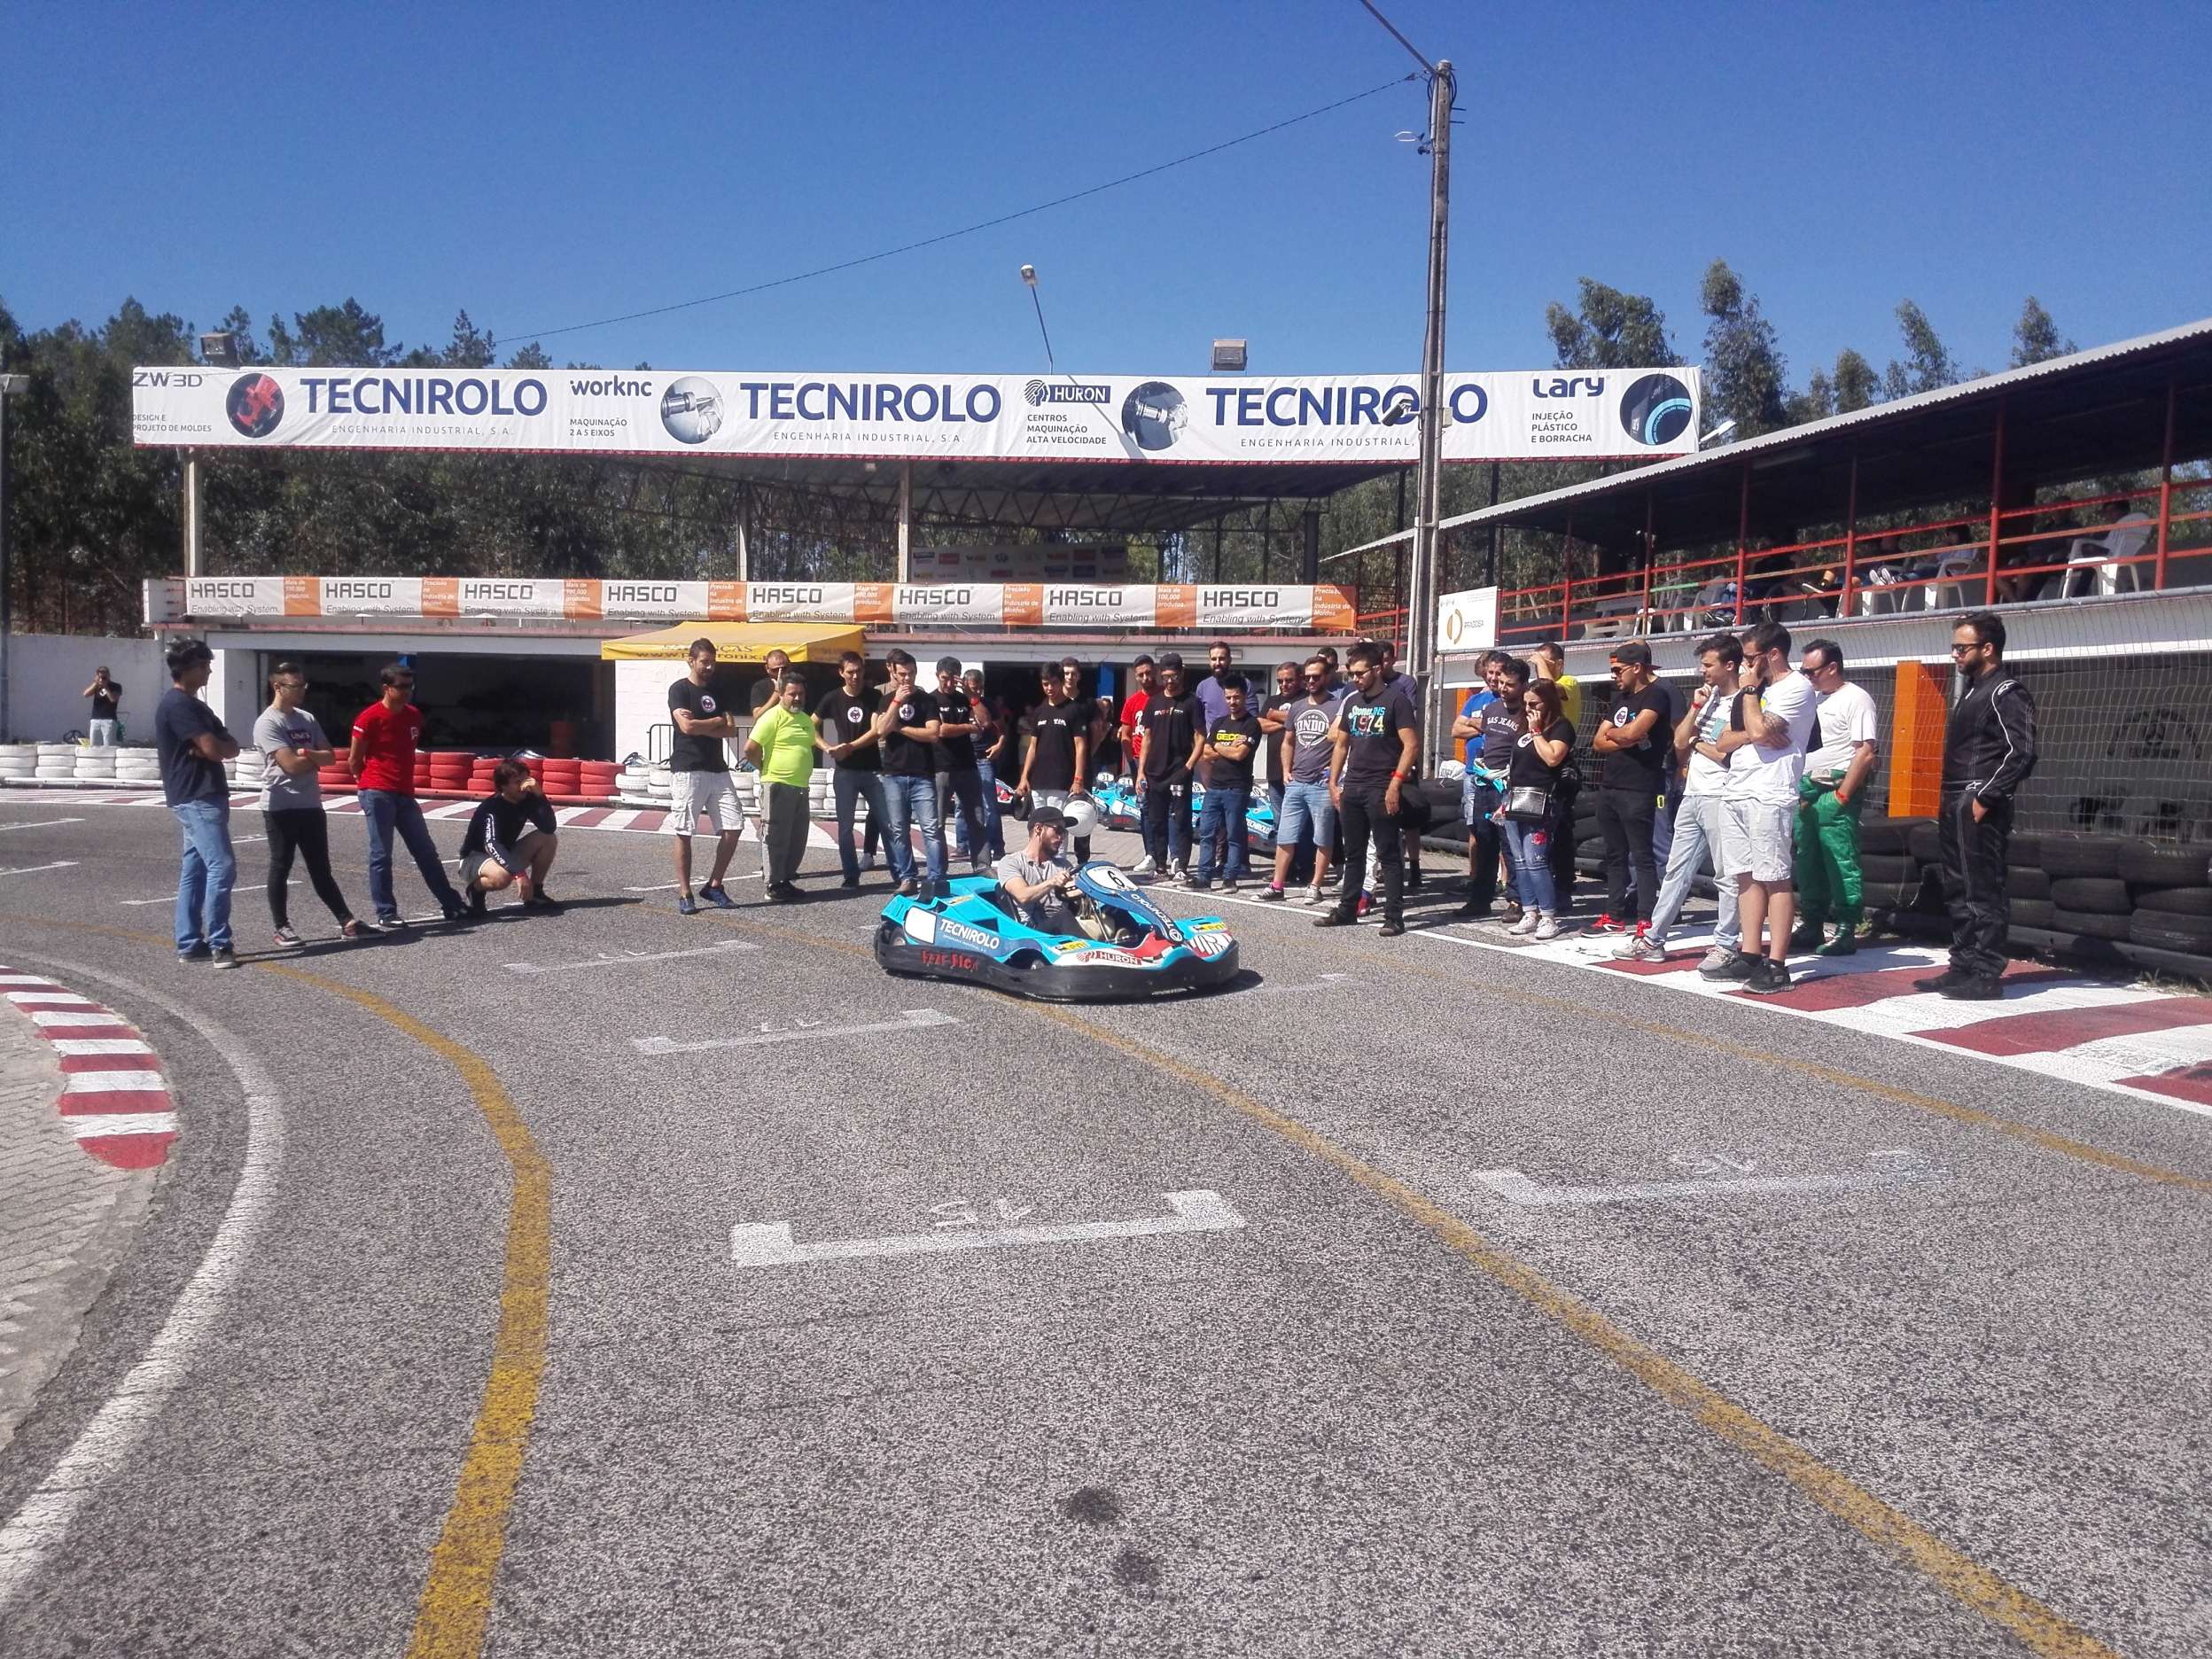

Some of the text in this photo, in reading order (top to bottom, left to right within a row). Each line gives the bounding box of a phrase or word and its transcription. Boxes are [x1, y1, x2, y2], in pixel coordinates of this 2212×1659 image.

[570, 375, 652, 397] worknc
[1055, 386, 1106, 401] HURON
[300, 377, 548, 417] TECNIROLO
[740, 382, 1001, 423] TECNIROLO
[1206, 383, 1488, 427] TECNIROO
[570, 417, 627, 427] MAQUINAÇÃO
[1532, 410, 1573, 421] INJEÇÃO
[412, 426, 484, 436] INDUSTRIAL,
[1027, 424, 1087, 434] MAQUINAÇÃO
[1531, 422, 1577, 432] PLÁSTICO
[774, 432, 851, 441] ENGENHARIA
[858, 432, 935, 443] INDUSTRIAL,
[1051, 436, 1107, 445] VELOCIDADE
[1241, 437, 1414, 448] ENGENHARIA INDUSTRIAL,
[1539, 434, 1593, 443] BORRACHA
[191, 583, 254, 598] HASCO
[326, 583, 392, 598] HASCO
[464, 584, 534, 600] HASCO
[608, 586, 677, 603] HASCO
[753, 588, 822, 604] HASCO
[900, 589, 970, 605] HASCO
[1049, 589, 1123, 606] HASCO
[1203, 591, 1279, 608] HASCO
[900, 611, 939, 621] Enabling
[1049, 612, 1089, 623] Enabling
[1203, 614, 1244, 625] Enabling
[1247, 614, 1266, 623] with
[1108, 870, 1125, 888] 6
[1131, 893, 1174, 930] TECNIROLO
[940, 919, 1000, 950] TECNIROLO
[1099, 951, 1139, 965] HURON
